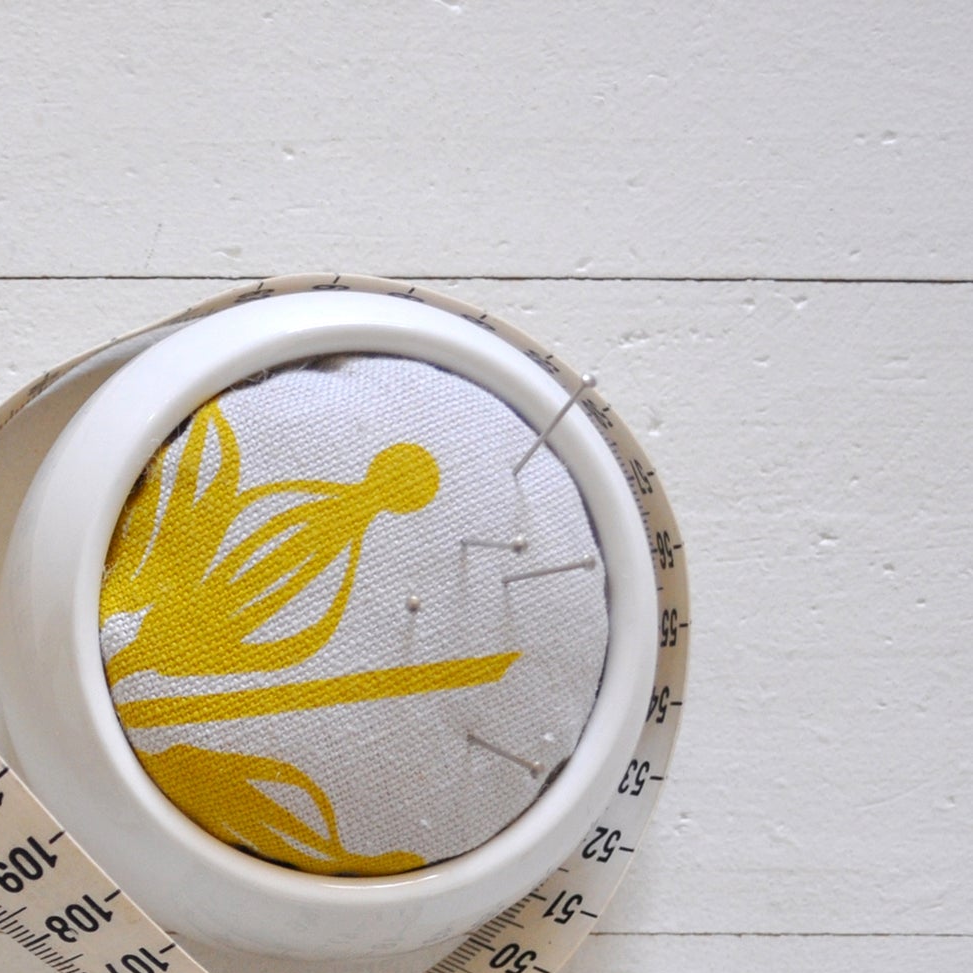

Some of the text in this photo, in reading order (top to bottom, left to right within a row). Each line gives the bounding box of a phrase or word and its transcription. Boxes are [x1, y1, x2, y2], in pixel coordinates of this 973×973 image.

[656, 530, 674, 569] 56
[660, 608, 677, 647] 55
[645, 685, 670, 723] 54
[618, 759, 650, 796] 53
[582, 826, 621, 863] 52
[44, 894, 113, 943] 108
[543, 890, 583, 925] 51
